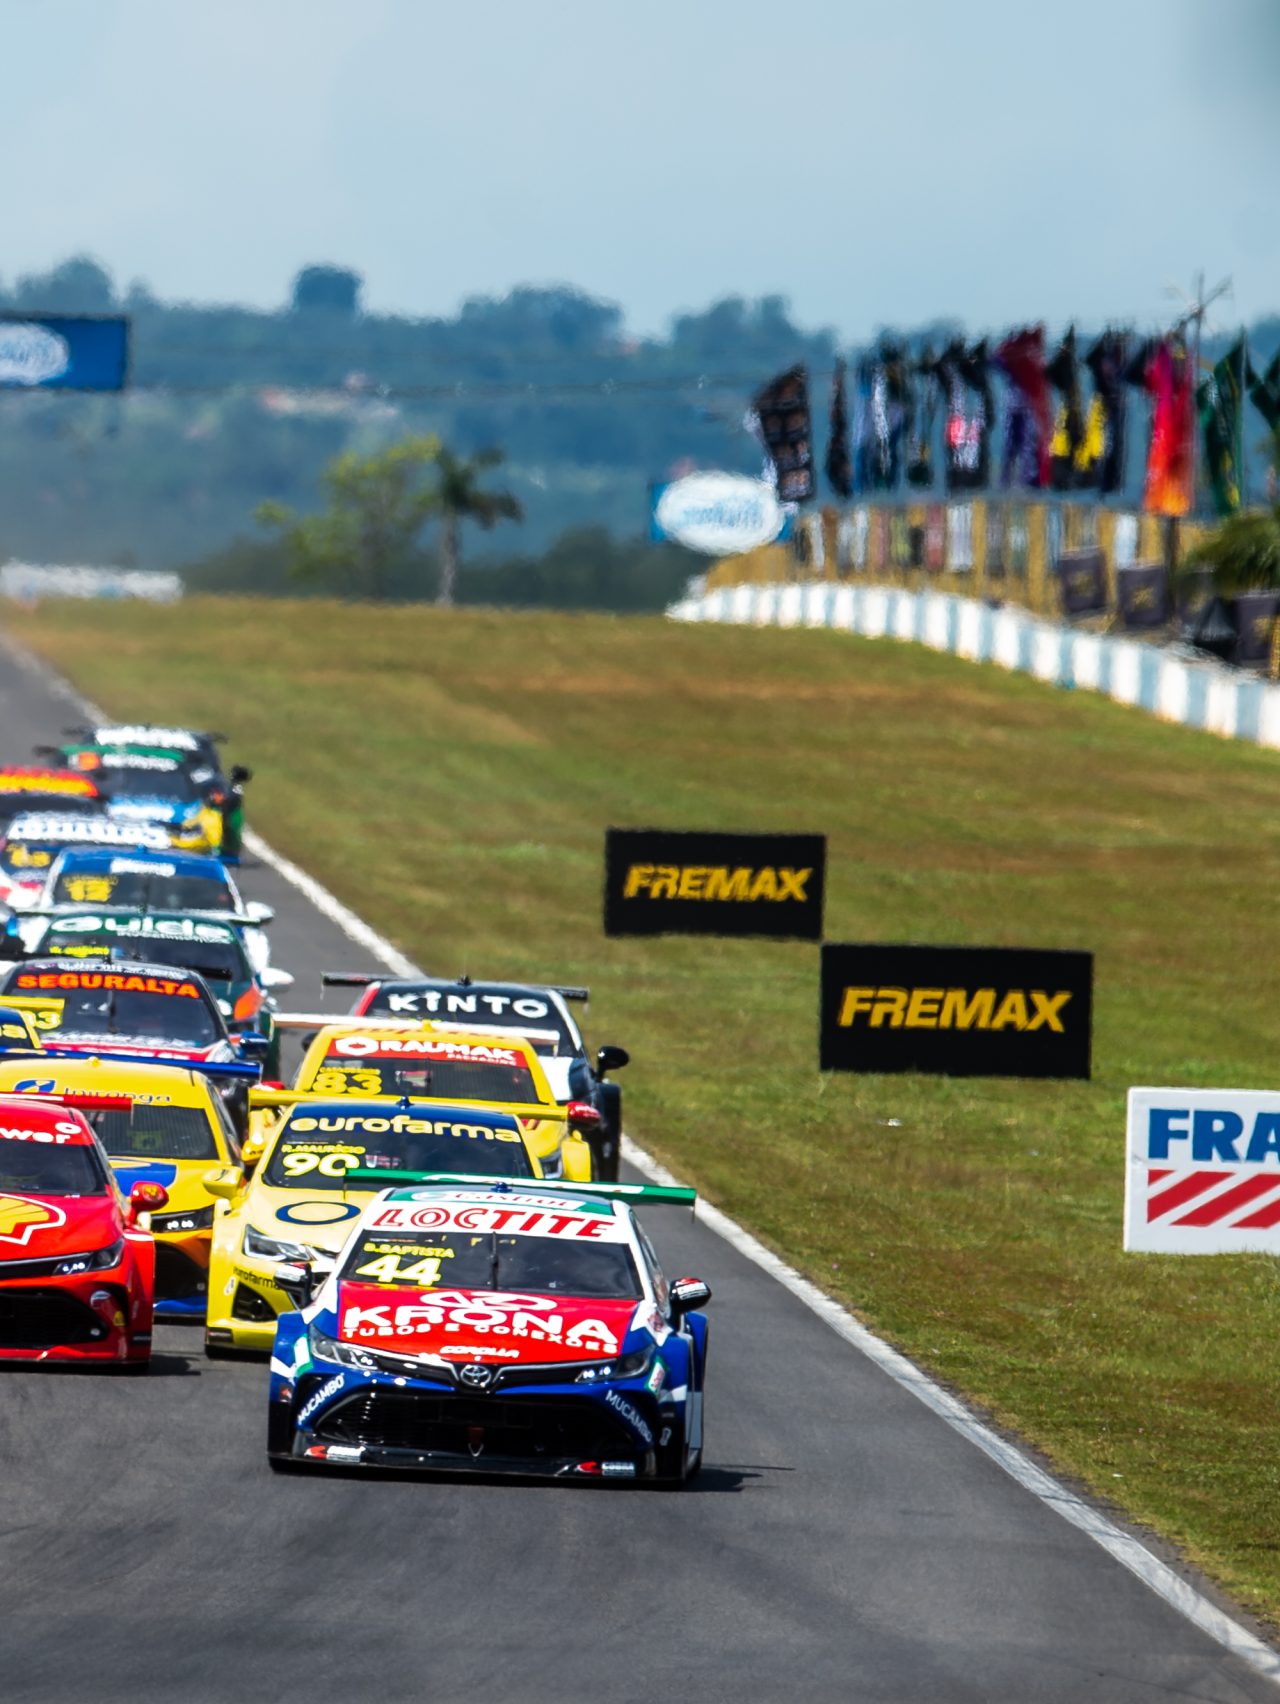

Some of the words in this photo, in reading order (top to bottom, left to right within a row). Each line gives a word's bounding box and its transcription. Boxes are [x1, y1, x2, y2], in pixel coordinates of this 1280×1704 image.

[624, 865, 813, 902] FREMAX
[51, 916, 235, 939] Guide
[18, 972, 200, 999] SEGURALTA
[388, 990, 548, 1018] KINTO
[838, 986, 1073, 1032] FREMAX
[381, 1040, 516, 1060] RAUMAK
[312, 1073, 382, 1095] 83
[290, 1115, 522, 1143] eurofarma
[282, 1153, 360, 1177] 90
[372, 1207, 615, 1238] LOCTITE
[355, 1254, 441, 1286] 44
[343, 1305, 618, 1344] KRONA
[343, 1323, 432, 1339] TUBOS
[445, 1322, 460, 1332] E
[439, 1345, 520, 1359] COROLLA
[296, 1372, 345, 1426] MUCAMBO
[605, 1389, 654, 1443] MUCAMBO
